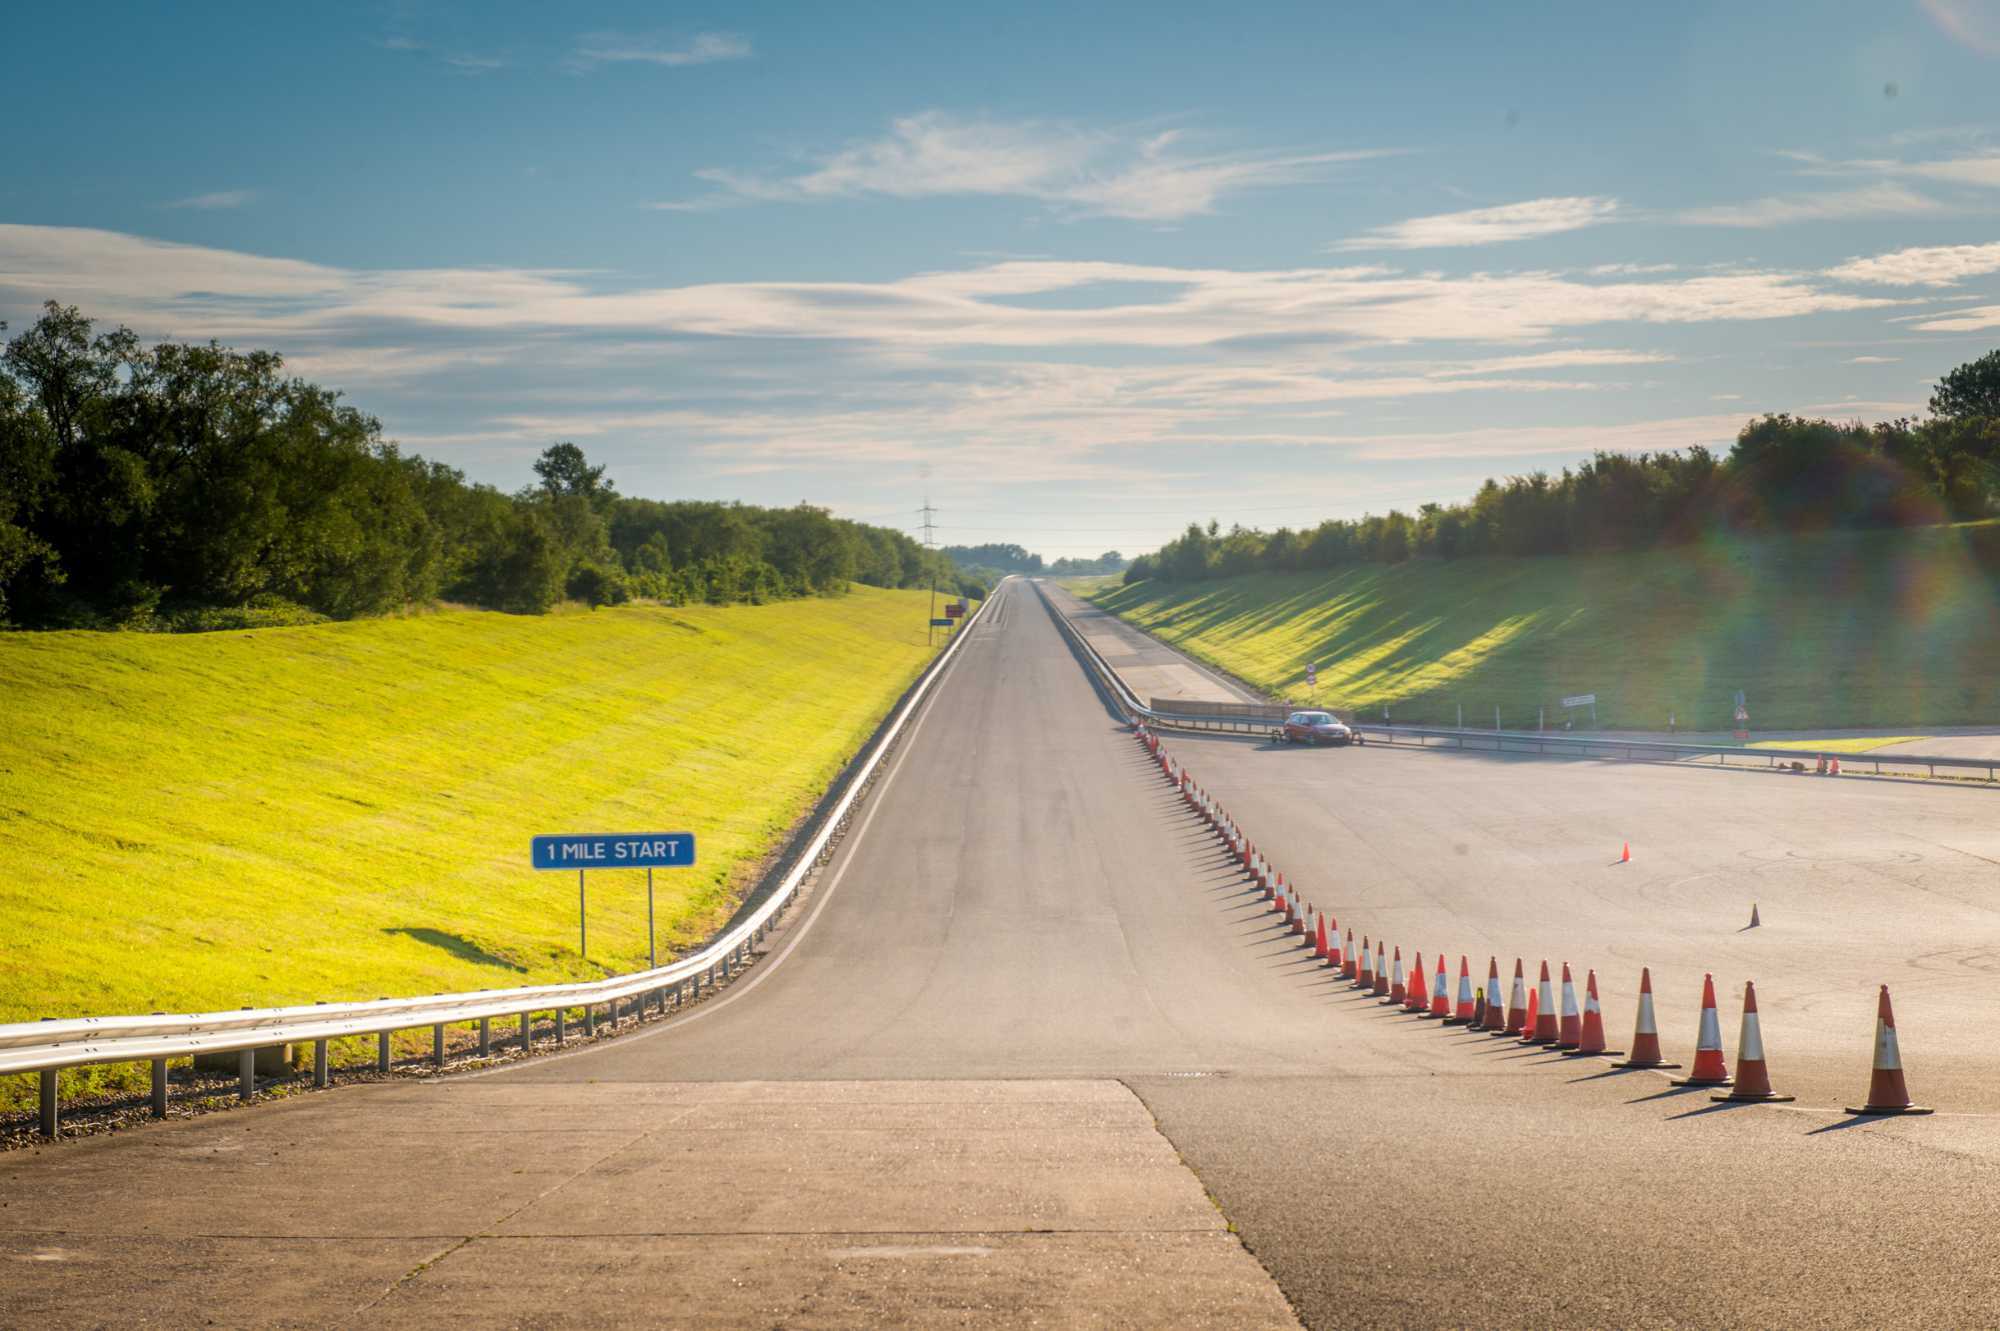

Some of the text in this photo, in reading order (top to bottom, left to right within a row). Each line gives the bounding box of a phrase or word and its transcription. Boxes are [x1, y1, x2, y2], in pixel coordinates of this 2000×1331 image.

[547, 841, 679, 860] 1 MILE START
